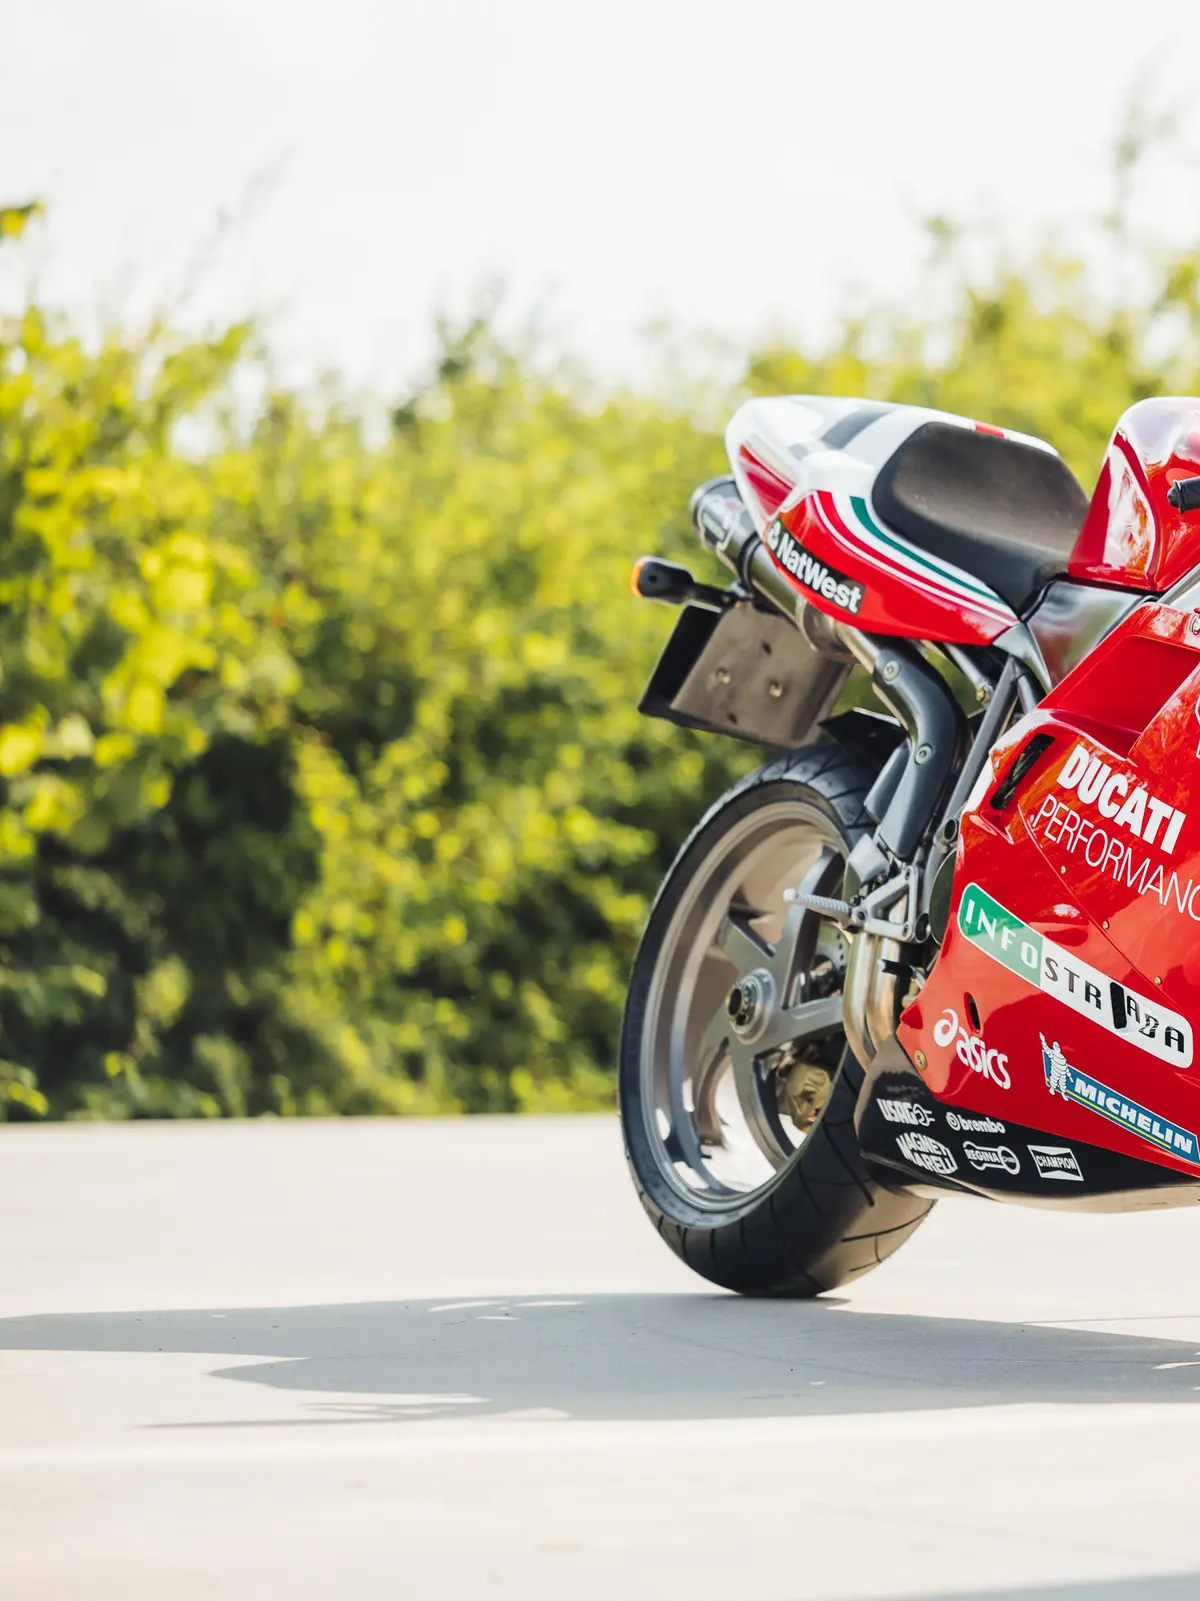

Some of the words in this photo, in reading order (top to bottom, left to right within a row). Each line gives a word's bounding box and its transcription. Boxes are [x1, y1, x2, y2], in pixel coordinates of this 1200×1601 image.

[776, 532, 862, 614] NatWest
[1056, 744, 1187, 855] DUCATI
[955, 1025, 1012, 1090] asics
[876, 1098, 920, 1126] USAG
[958, 1114, 1006, 1134] brembo
[1074, 1077, 1193, 1154] MICHELIN
[963, 1149, 1001, 1163] REGINA
[1035, 1155, 1077, 1170] CHAMPION
